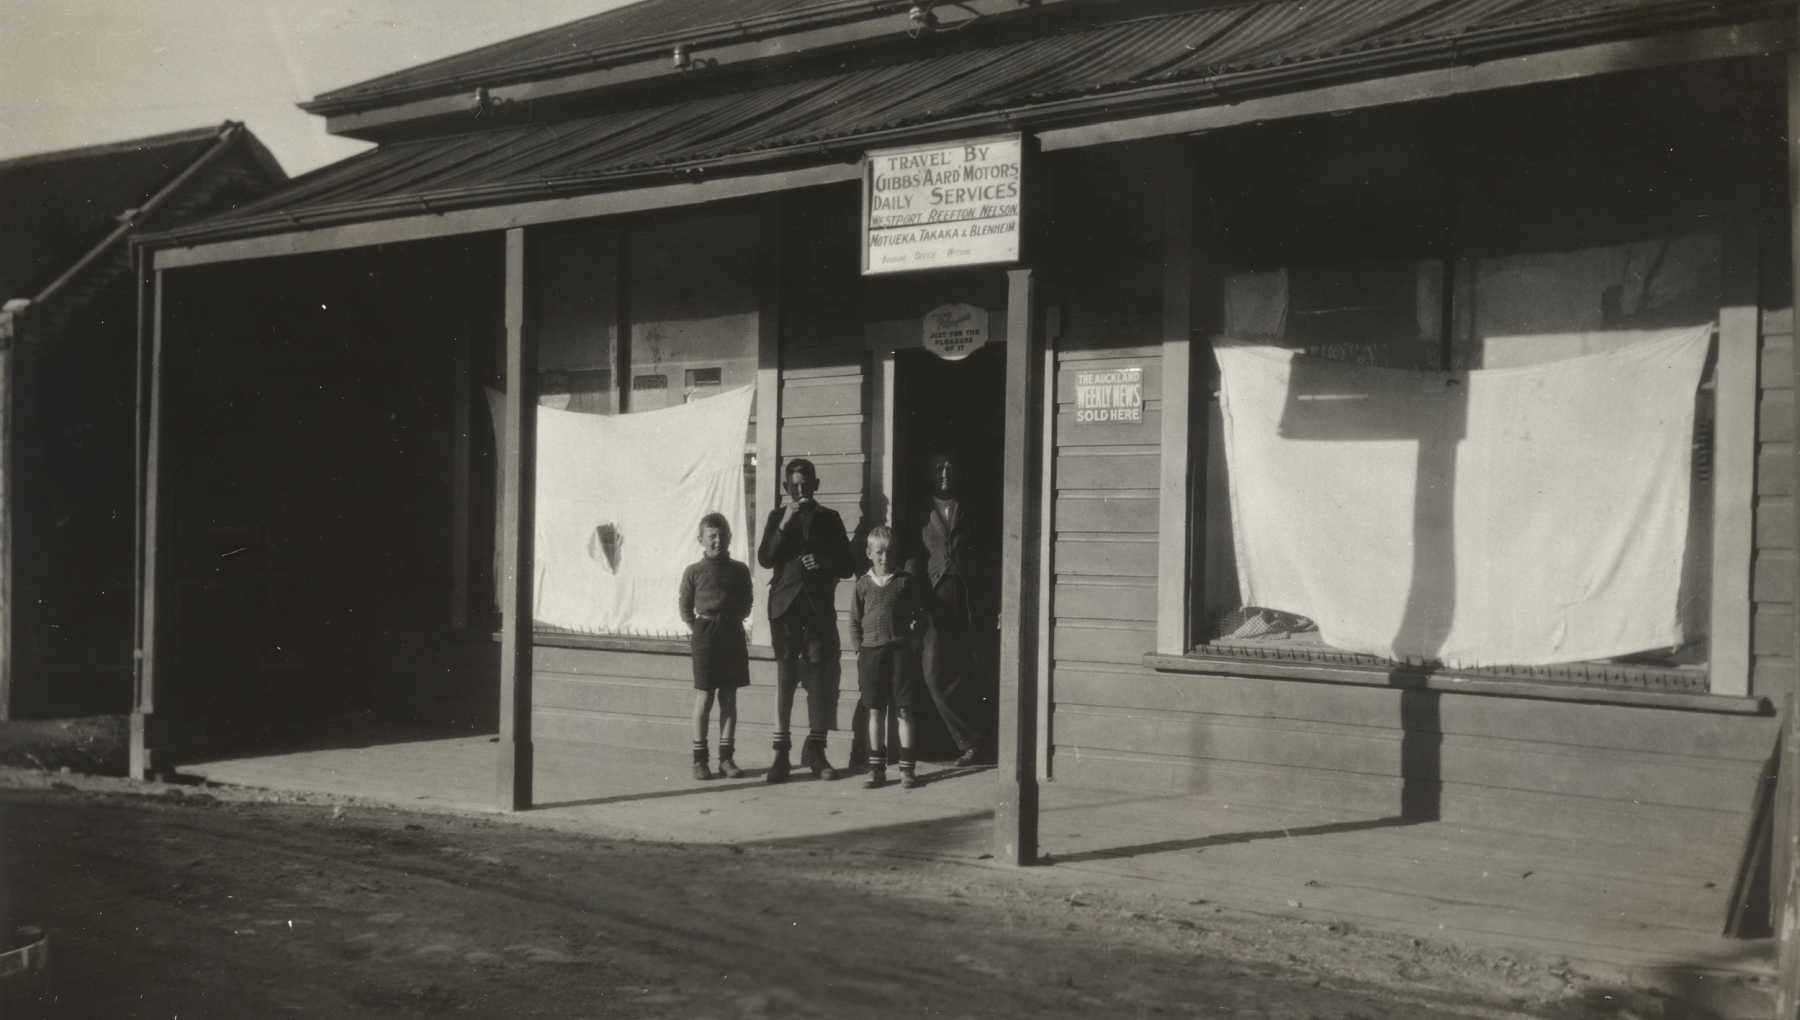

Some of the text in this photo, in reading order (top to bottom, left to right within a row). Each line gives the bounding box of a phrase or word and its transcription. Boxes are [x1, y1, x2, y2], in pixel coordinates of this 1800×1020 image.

[964, 145, 990, 163] BY
[963, 162, 1019, 183] MOTORS
[873, 181, 1018, 212] DAILY SERVICES
[919, 228, 959, 243] TAKAKA
[961, 229, 968, 238] &
[914, 251, 937, 261] OFFICE
[949, 330, 963, 338] FOR
[965, 328, 980, 336] THE
[934, 337, 974, 346] PLEASURE
[944, 344, 965, 353] OF IT
[1078, 371, 1140, 385] THE AUCKLAND
[1077, 383, 1141, 409] WEEKLY NEWS
[1076, 408, 1140, 422] SOLD HERE
